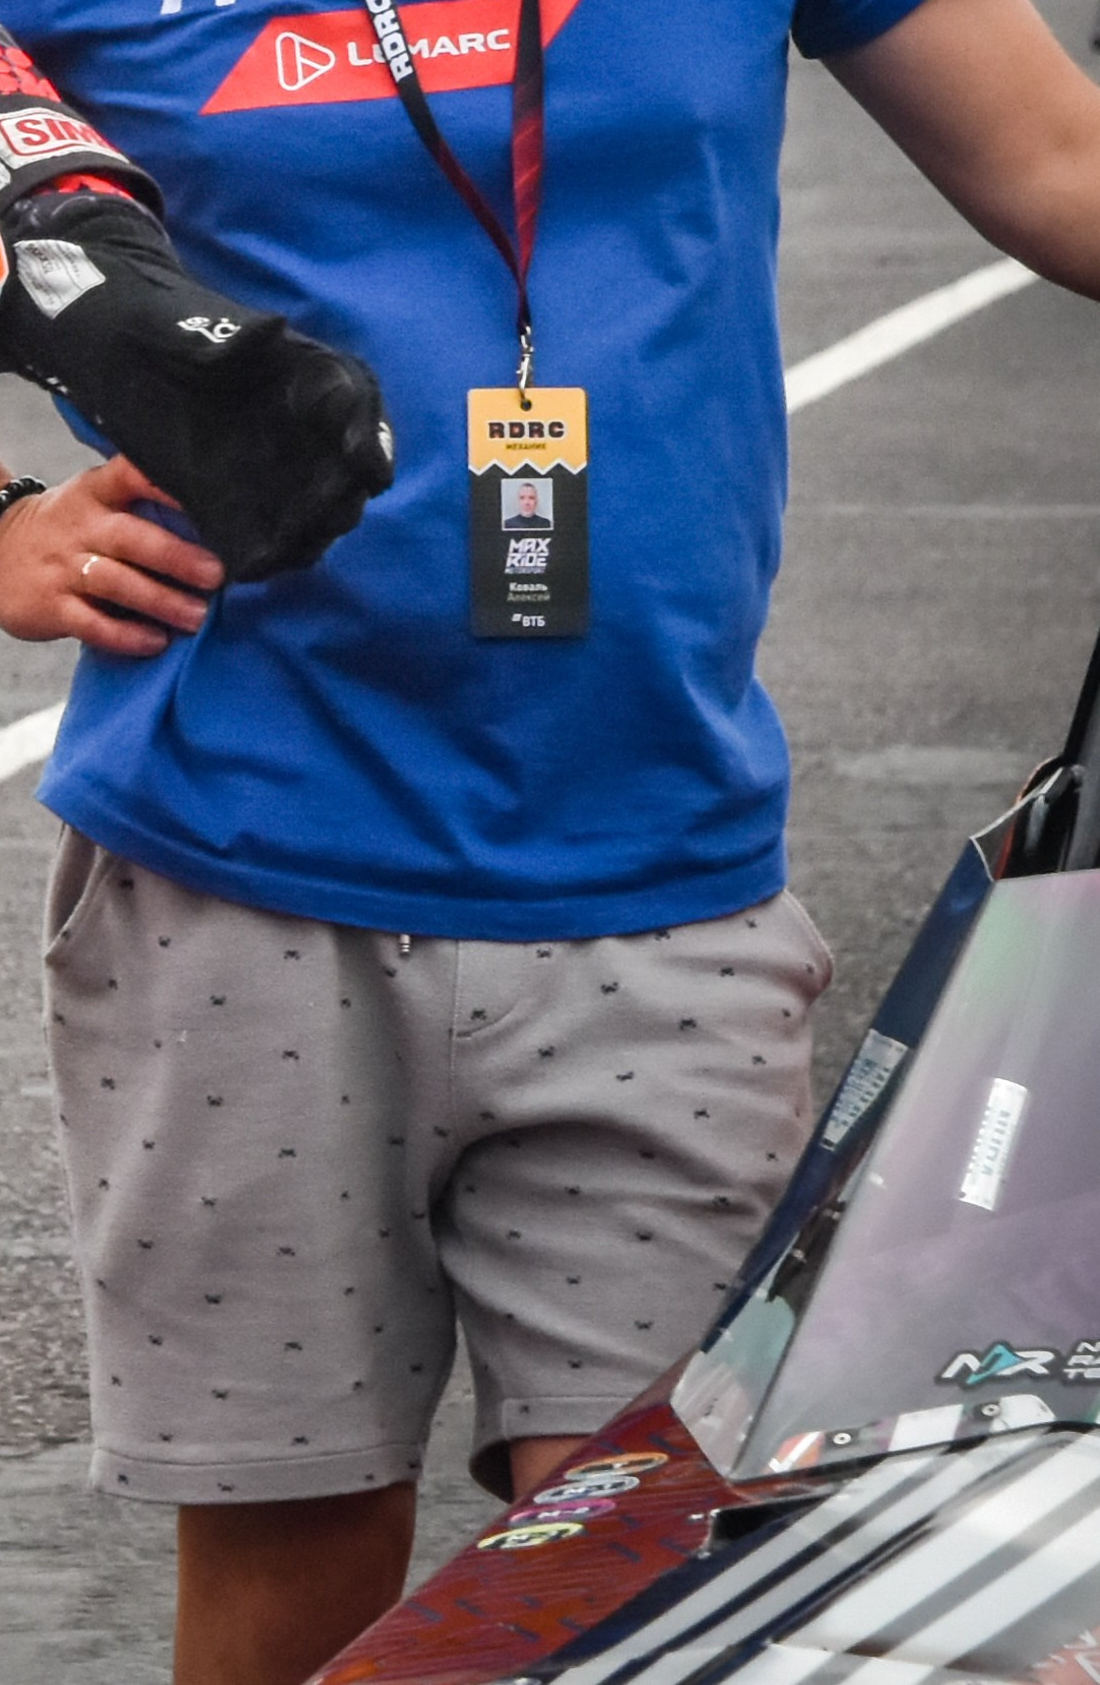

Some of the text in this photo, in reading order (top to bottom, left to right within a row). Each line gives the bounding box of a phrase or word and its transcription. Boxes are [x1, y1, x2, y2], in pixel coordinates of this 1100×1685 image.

[488, 421, 565, 439] RDRC
[509, 538, 552, 553] MAX
[505, 552, 550, 567] RIDE
[522, 615, 546, 627] ВТБ
